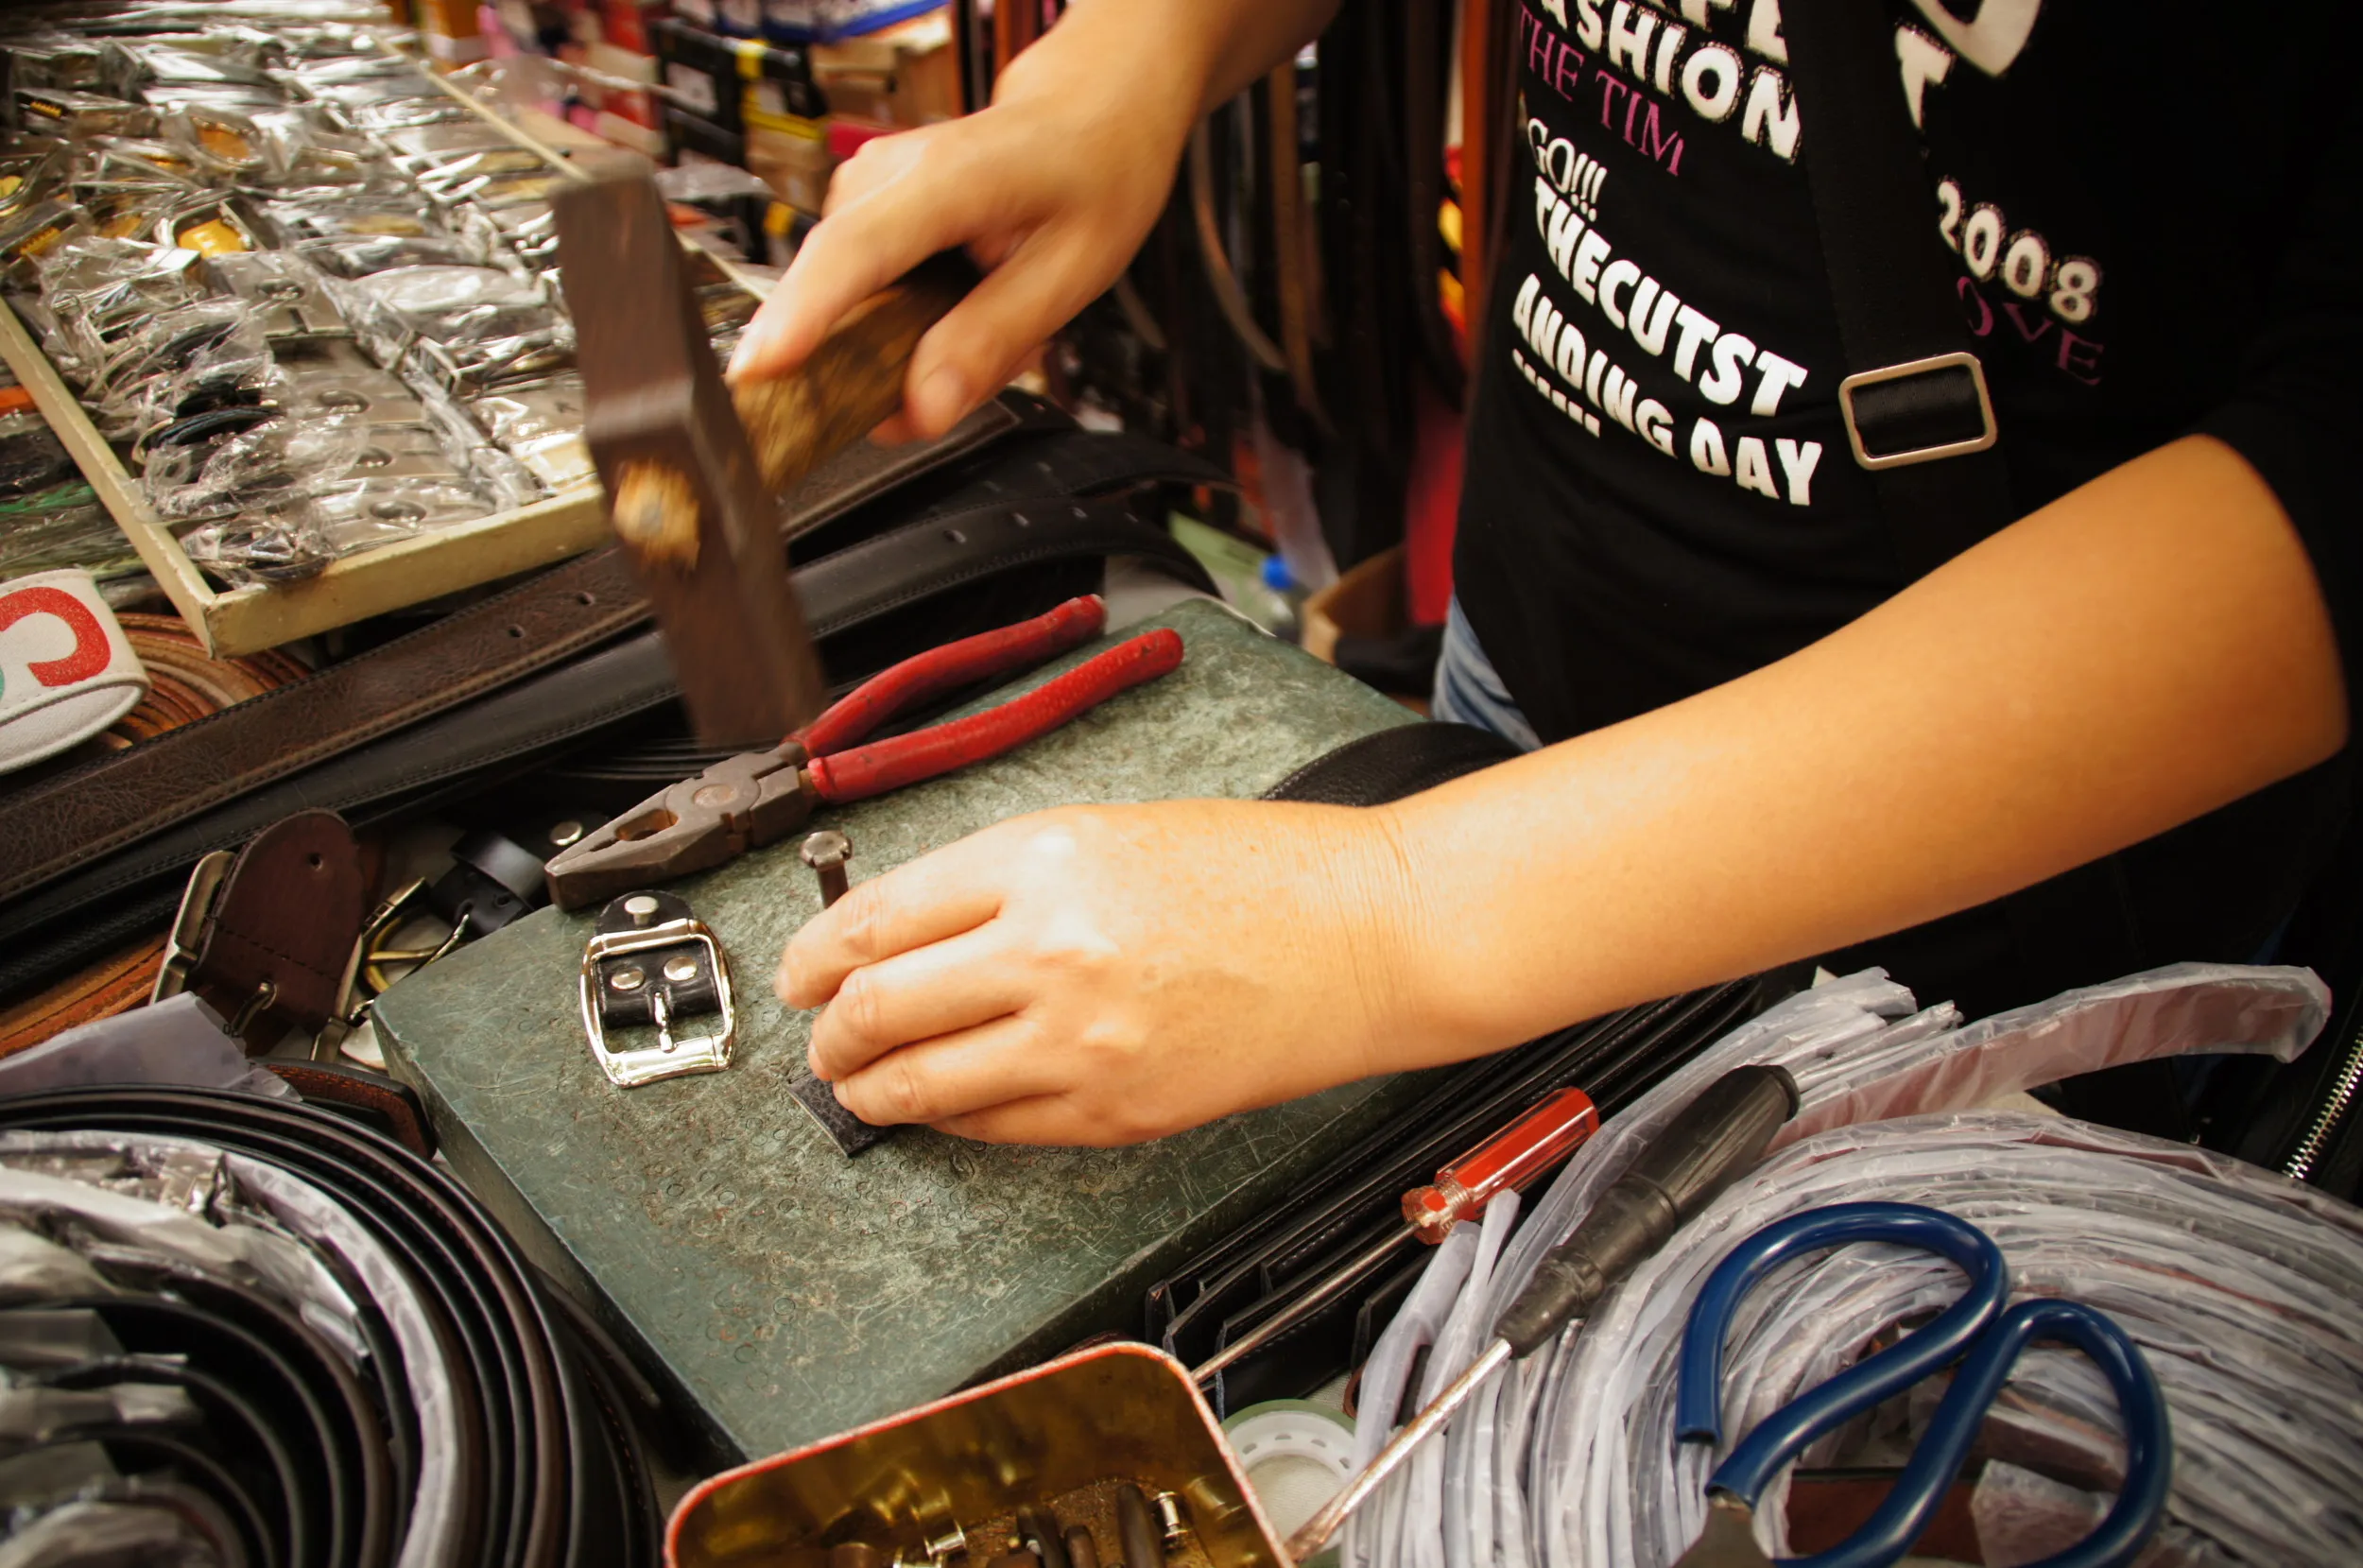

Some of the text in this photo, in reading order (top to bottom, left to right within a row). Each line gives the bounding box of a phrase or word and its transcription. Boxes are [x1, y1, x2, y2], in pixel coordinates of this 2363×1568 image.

[1519, 4, 1584, 102] THE
[1595, 69, 1685, 177] TIM
[1526, 117, 1607, 222] GO!!!
[1534, 175, 1809, 417] THECUTST
[1936, 176, 2102, 325] 2008
[1512, 272, 1823, 508] ANDING DAY
